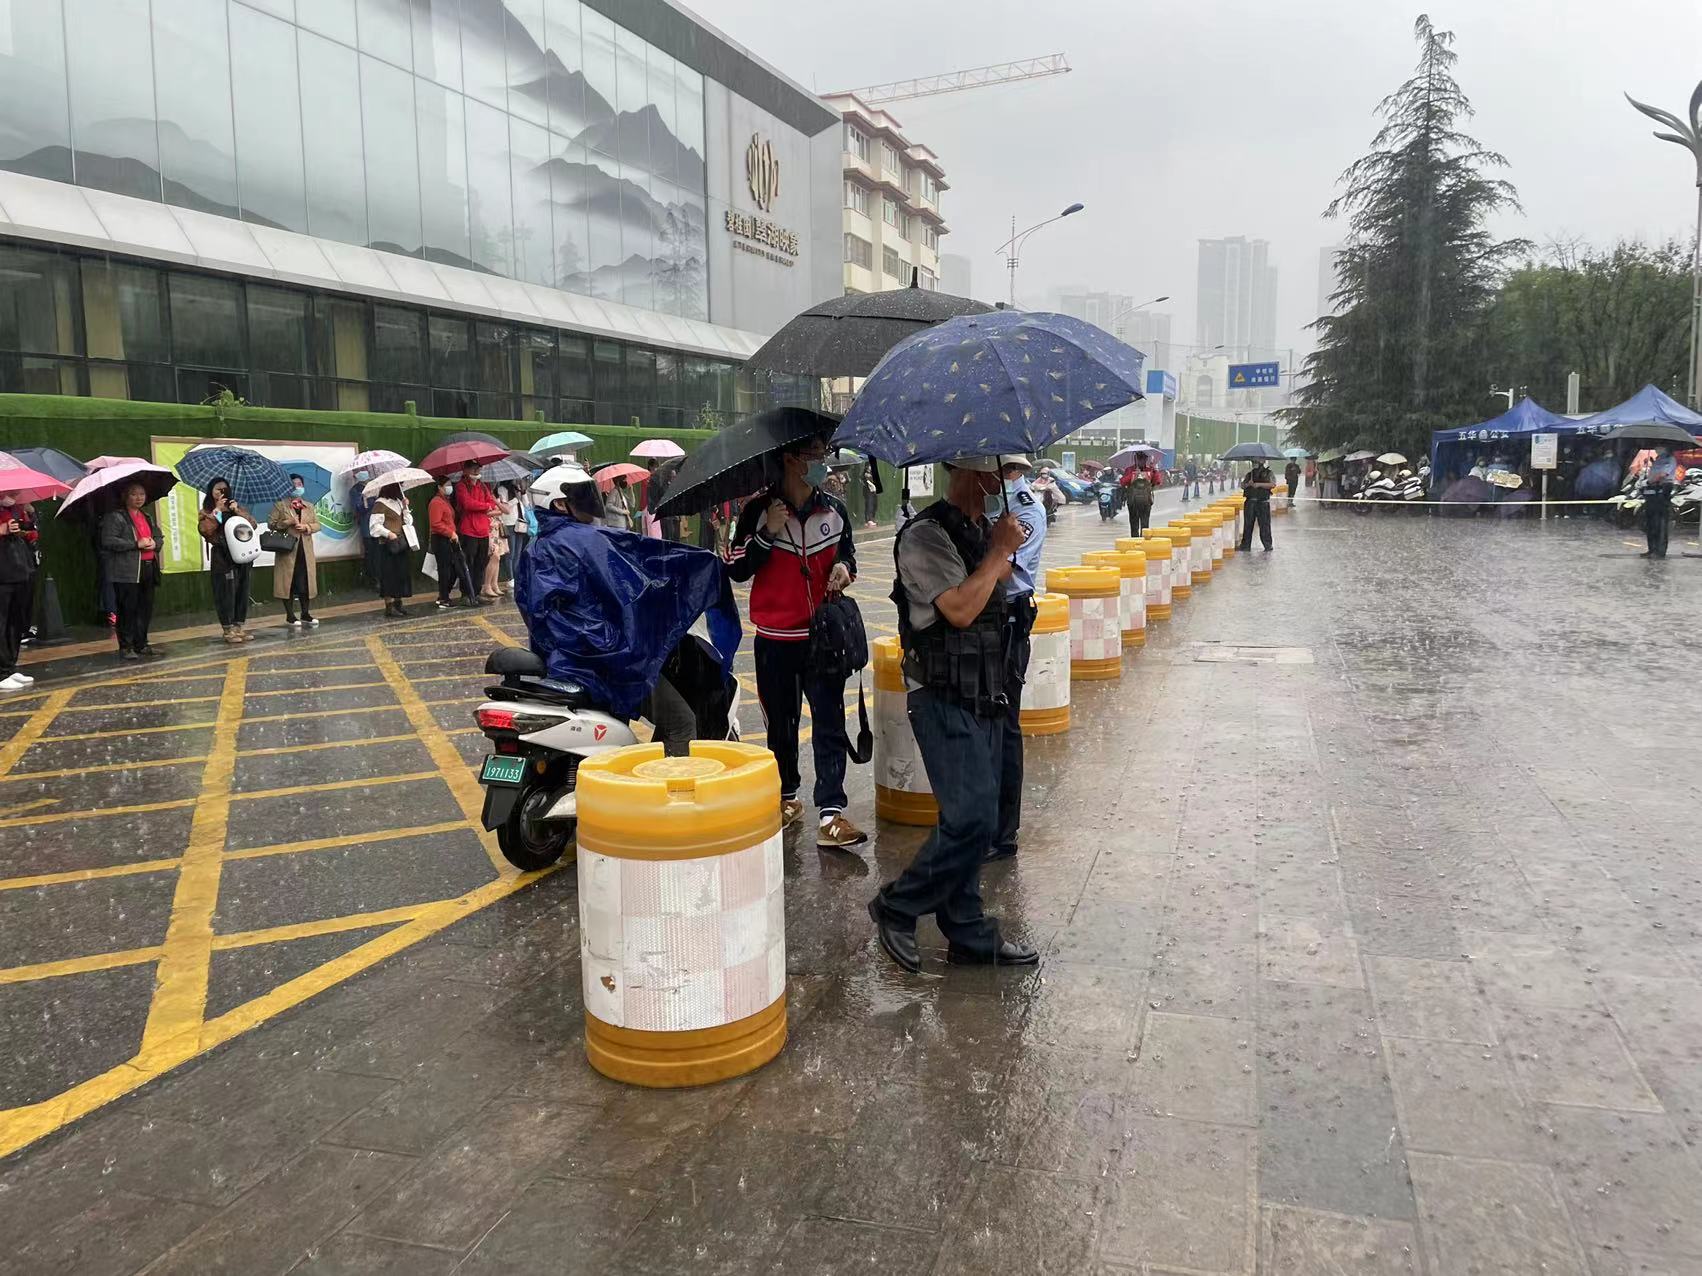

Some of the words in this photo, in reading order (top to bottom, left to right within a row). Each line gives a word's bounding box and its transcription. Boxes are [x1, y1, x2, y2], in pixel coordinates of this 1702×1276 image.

[1458, 431, 1477, 440] 五华
[486, 766, 520, 780] 1971133
[829, 824, 841, 838] N
